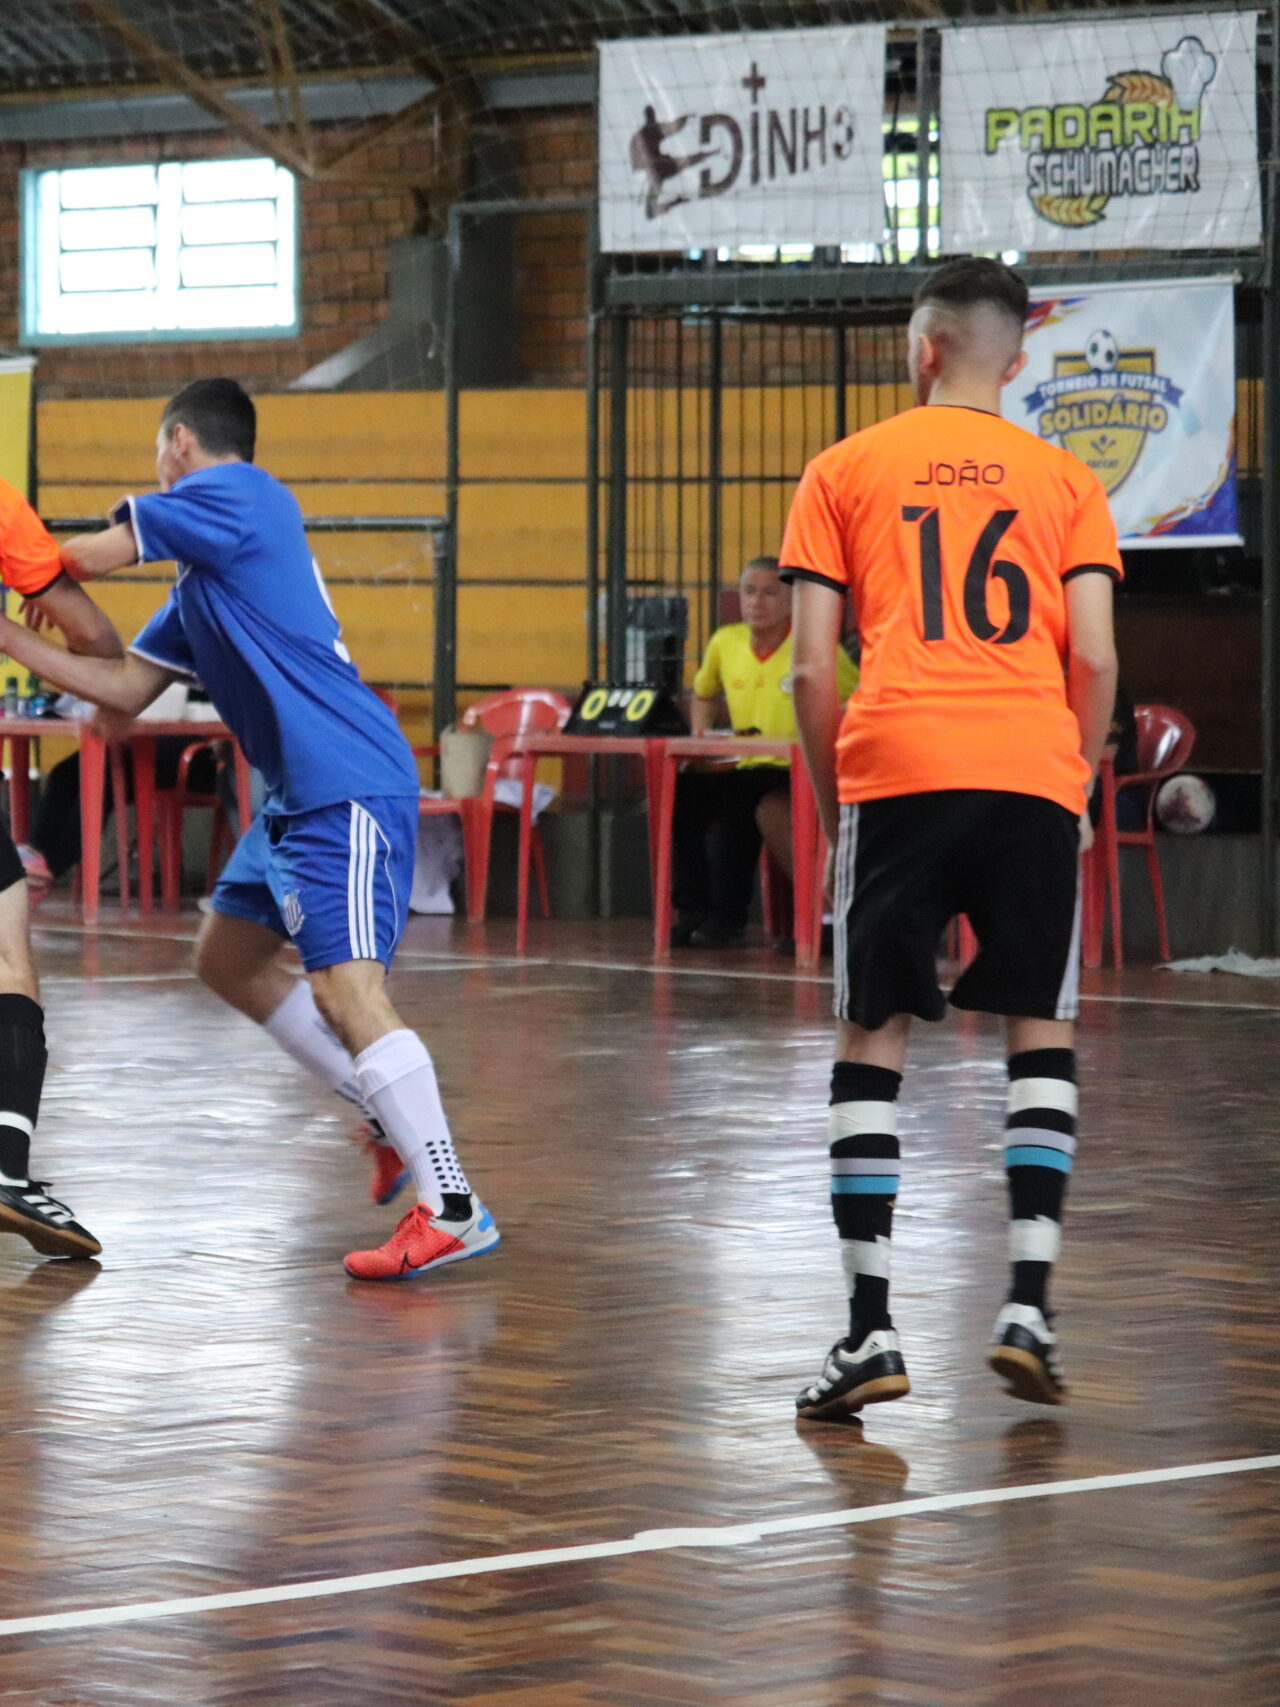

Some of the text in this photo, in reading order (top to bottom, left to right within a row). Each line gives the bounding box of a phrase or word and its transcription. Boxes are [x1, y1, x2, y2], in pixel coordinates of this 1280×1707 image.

[1028, 144, 1200, 199] SCHUMACHER
[1040, 373, 1167, 398] TORNEIO DE FUTSAL
[914, 459, 1005, 487] JOÃO
[902, 504, 1031, 644] 16
